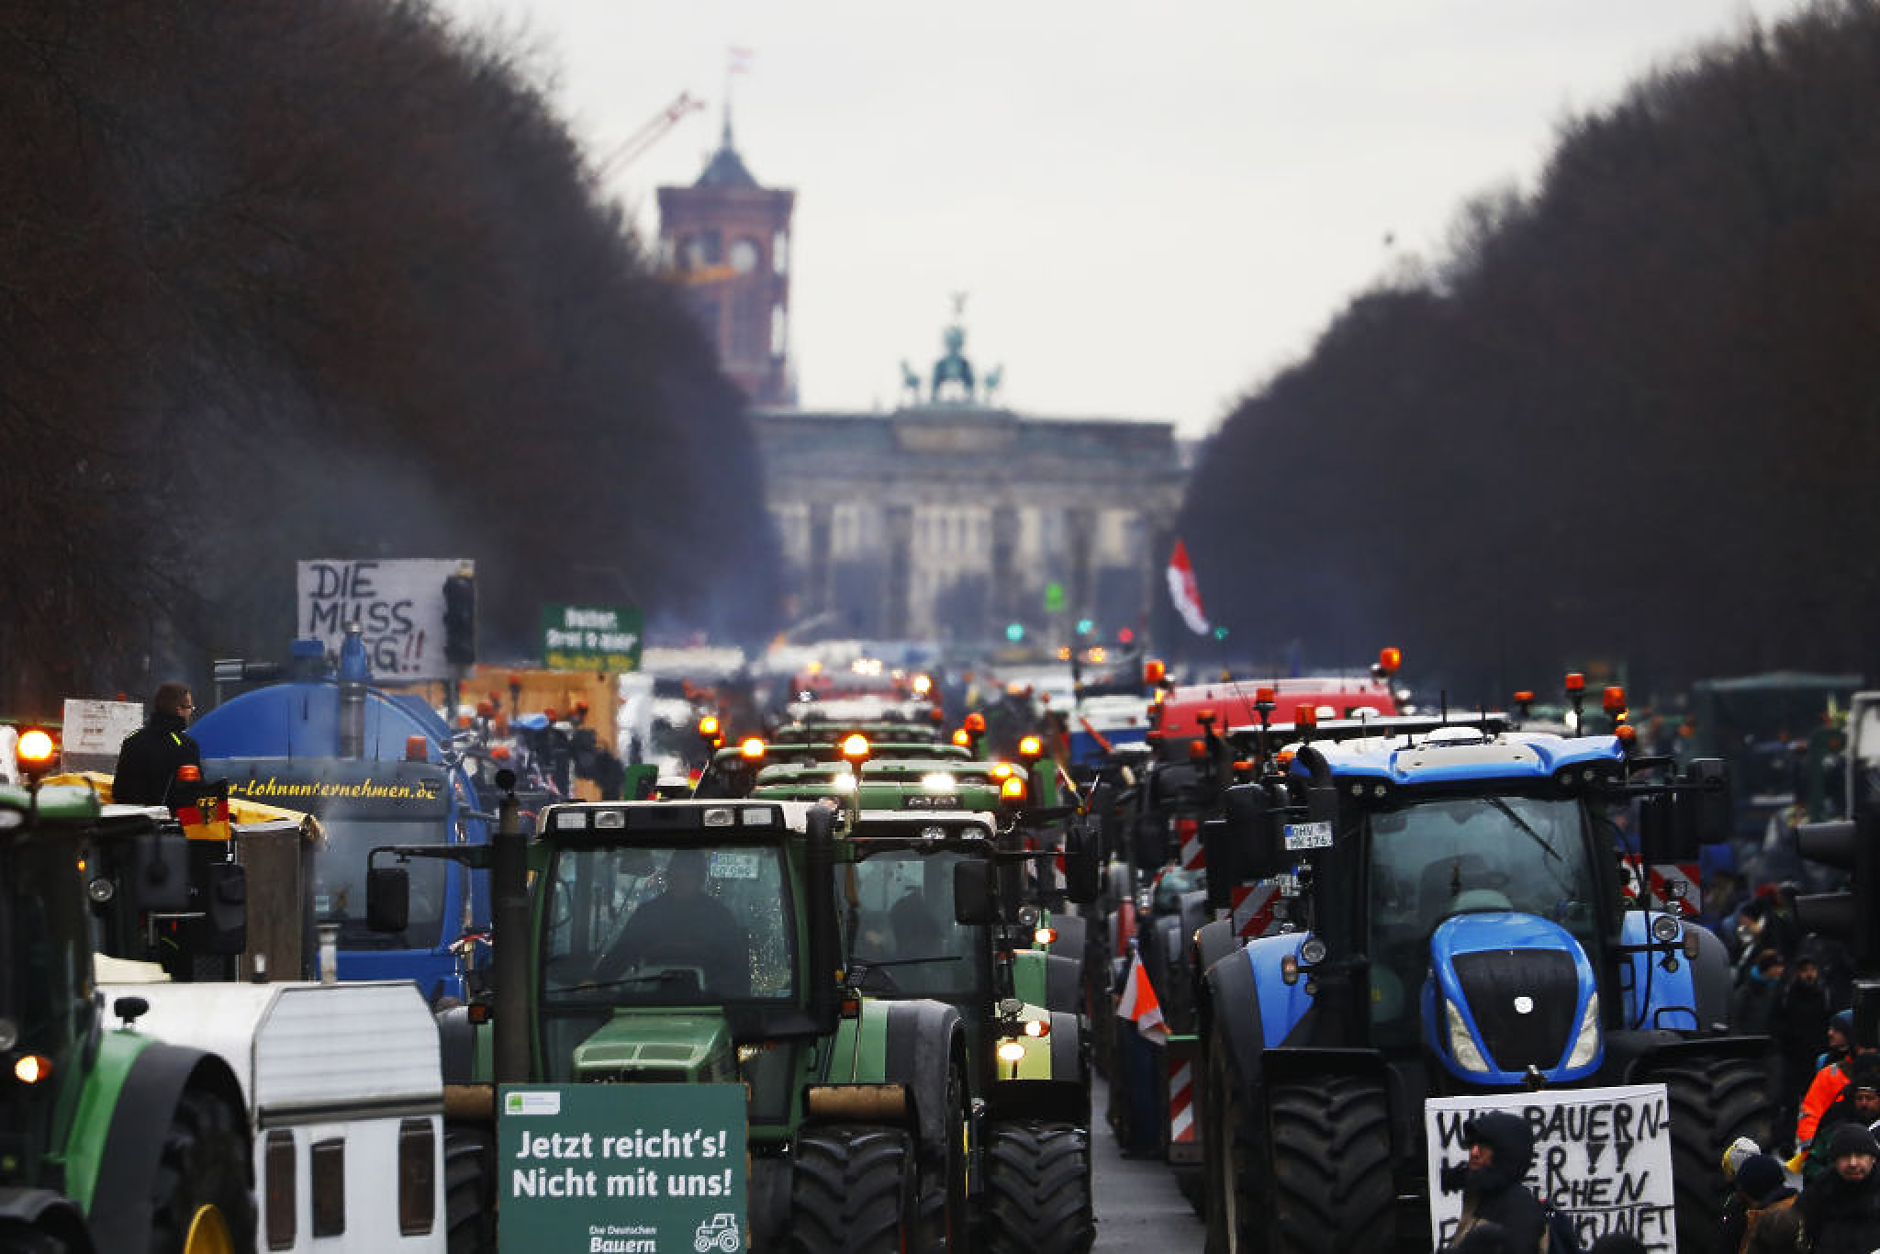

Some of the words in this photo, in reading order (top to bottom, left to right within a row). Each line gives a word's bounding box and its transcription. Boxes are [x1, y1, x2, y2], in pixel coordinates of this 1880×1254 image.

[308, 562, 379, 599] DIE
[310, 600, 414, 635] MUSS
[228, 776, 436, 800] r-Lohnunternehmen.de
[515, 1130, 594, 1158] Jetzt
[513, 1167, 598, 1198] Nicht
[607, 1167, 659, 1198] mit
[667, 1168, 733, 1198] uns!
[589, 1225, 606, 1235] Die
[607, 1225, 658, 1235] Deutschen
[590, 1237, 657, 1253] Bauern
